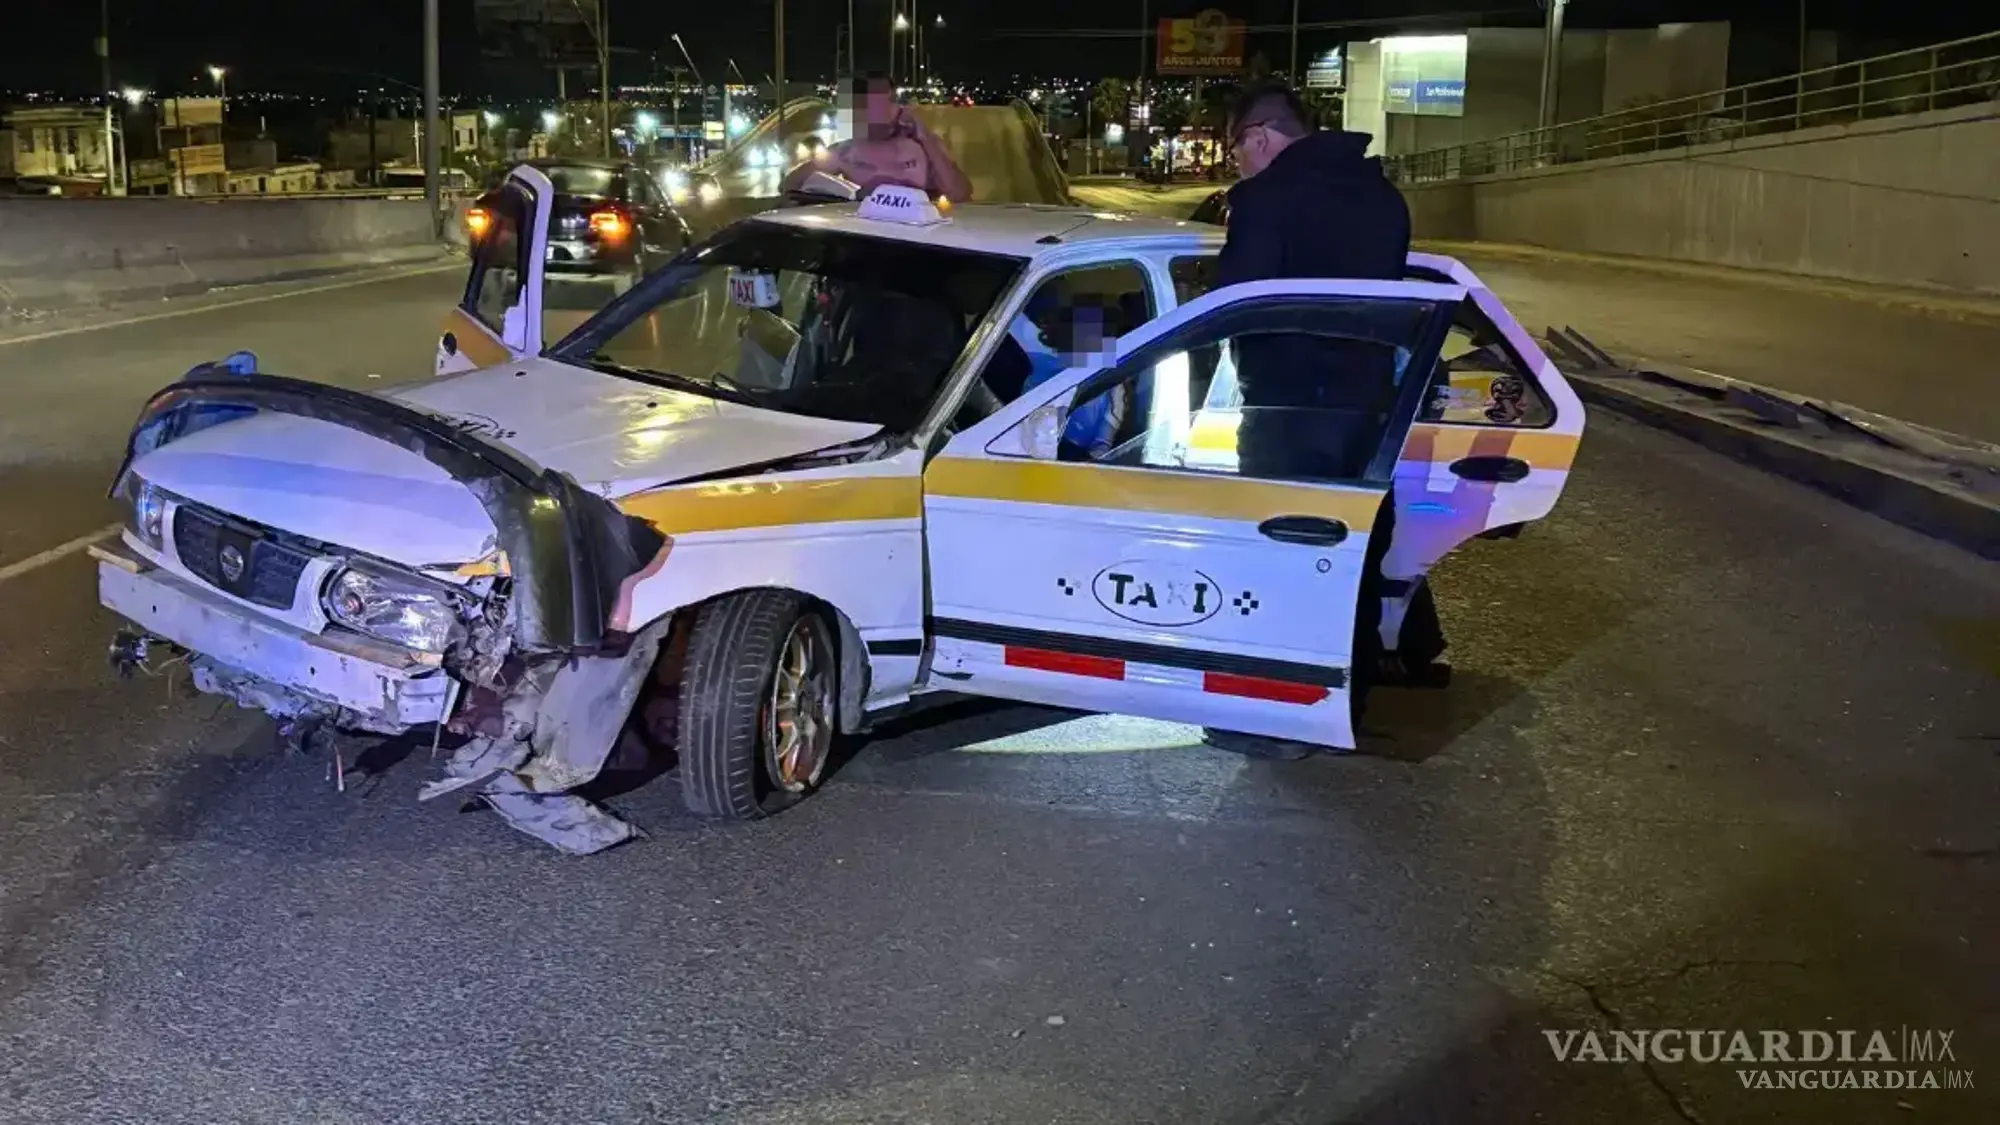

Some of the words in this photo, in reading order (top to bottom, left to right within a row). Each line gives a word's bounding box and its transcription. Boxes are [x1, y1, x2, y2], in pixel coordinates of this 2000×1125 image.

[1196, 56, 1242, 67] JUNTOS
[876, 193, 906, 208] TAXI
[731, 279, 755, 304] TAXI
